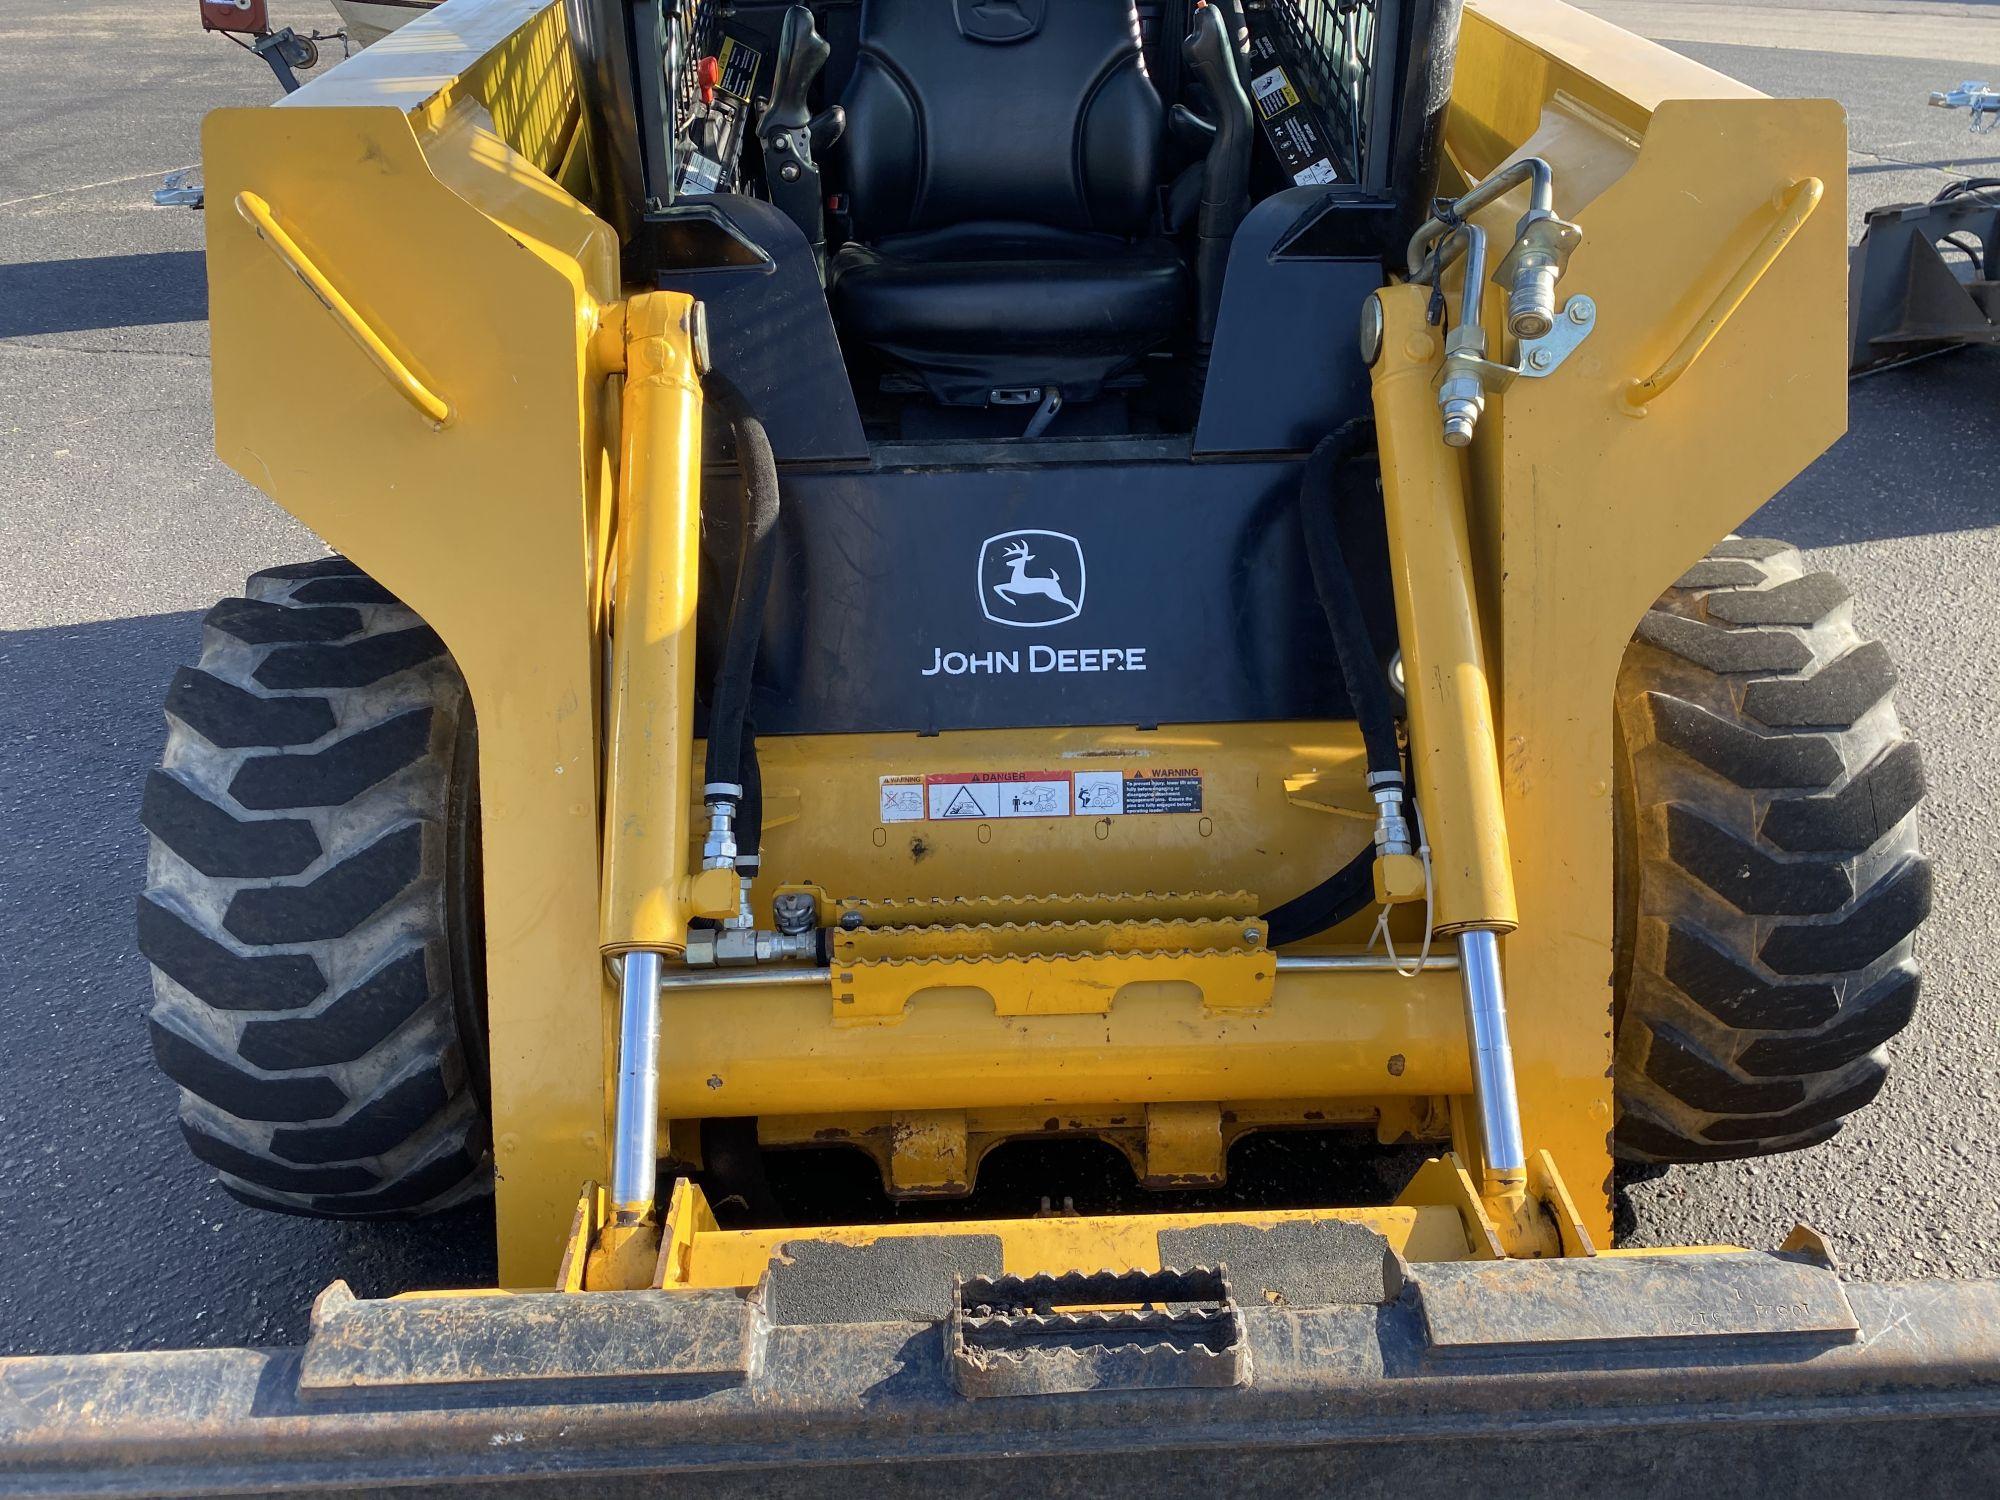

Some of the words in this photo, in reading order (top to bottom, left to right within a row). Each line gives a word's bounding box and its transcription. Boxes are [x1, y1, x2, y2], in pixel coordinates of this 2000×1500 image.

[922, 647, 1018, 676] JOHN
[1029, 645, 1146, 672] DEERE
[982, 772, 1026, 782] DANGER
[1152, 768, 1198, 777] WARNING
